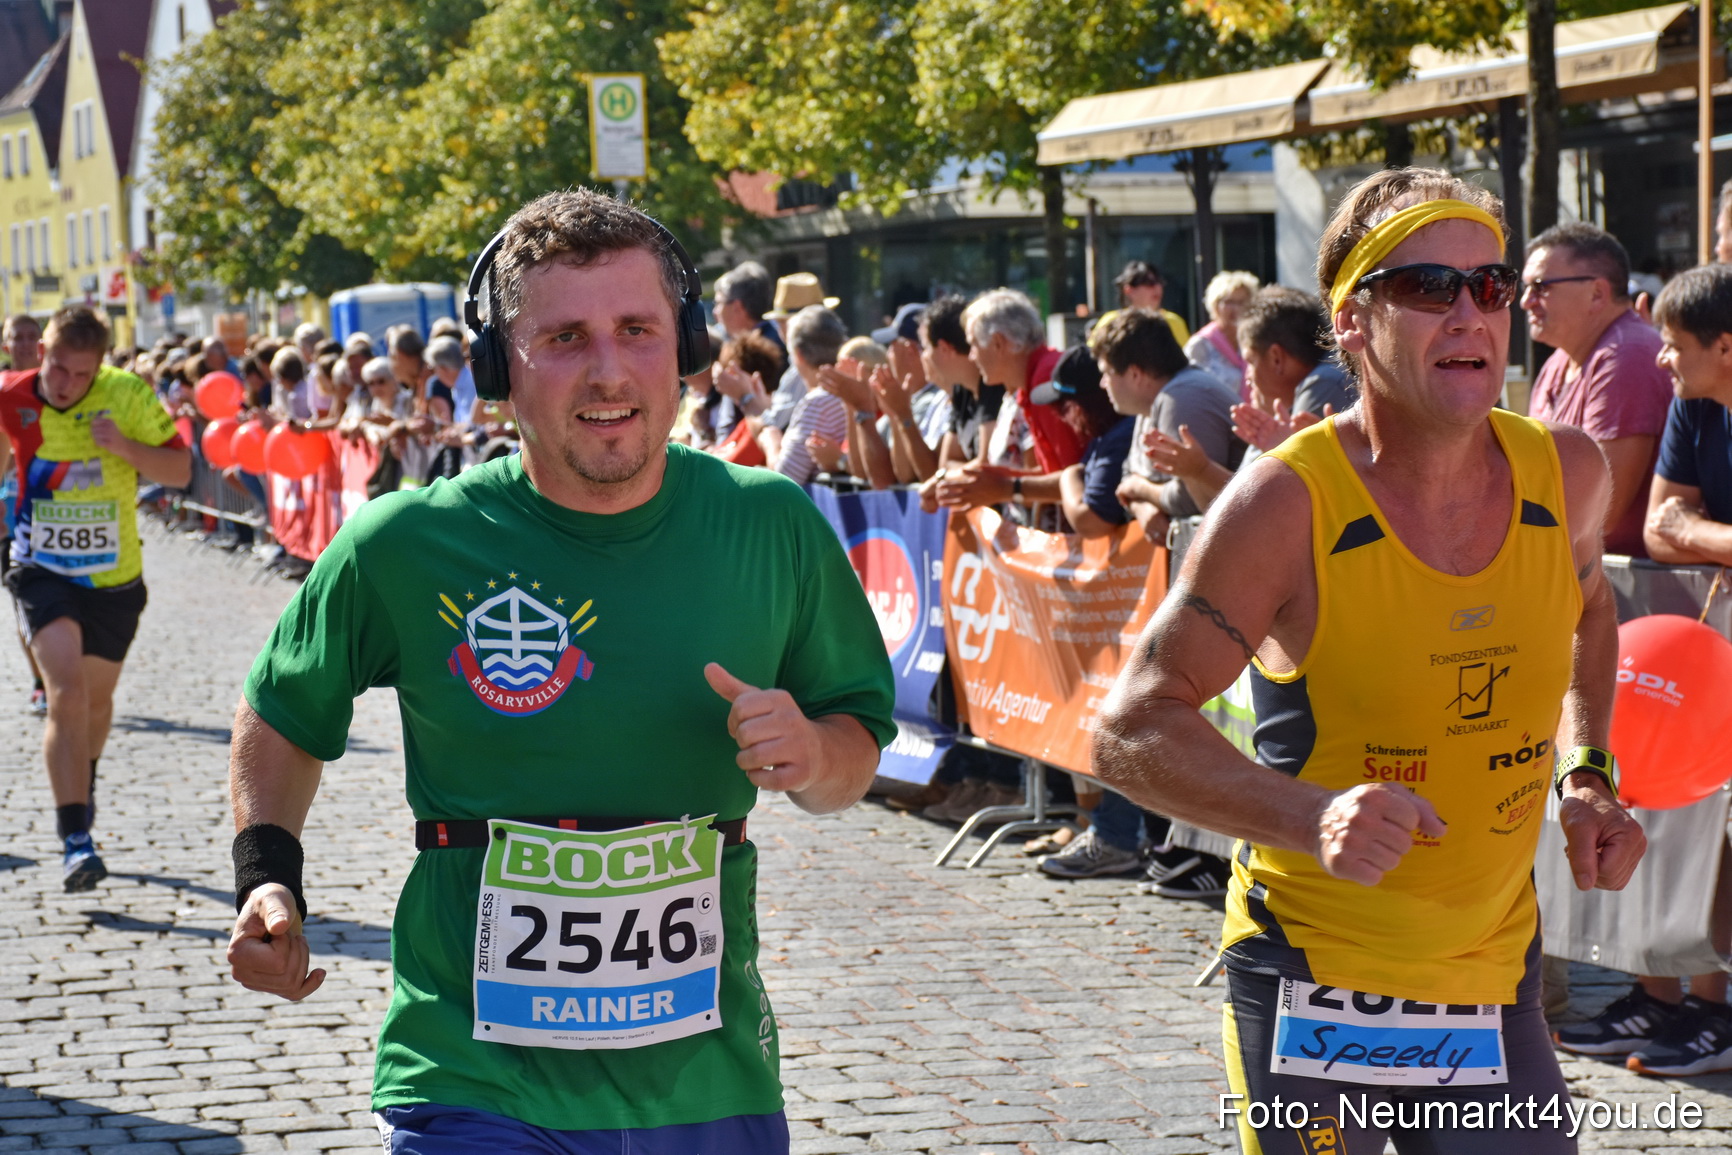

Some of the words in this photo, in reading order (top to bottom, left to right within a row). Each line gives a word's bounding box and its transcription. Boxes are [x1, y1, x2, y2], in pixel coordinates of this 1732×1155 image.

[39, 503, 111, 520] BOCK
[42, 527, 108, 550] 2685
[1430, 644, 1518, 666] FONDSZENTRUM
[1616, 657, 1684, 699] ÖDL
[472, 676, 565, 707] ROSARYVILLE
[1634, 687, 1681, 707] energie
[1446, 719, 1509, 737] NEUMARKT
[1365, 743, 1428, 757] Schreinerei
[1363, 757, 1427, 782] Seidl
[504, 829, 700, 887] BOCK
[701, 897, 710, 910] C
[506, 897, 697, 974] 2546
[1282, 978, 1294, 1010] ZEITG
[532, 990, 675, 1024] RAINER
[1300, 1025, 1473, 1085] Speedy
